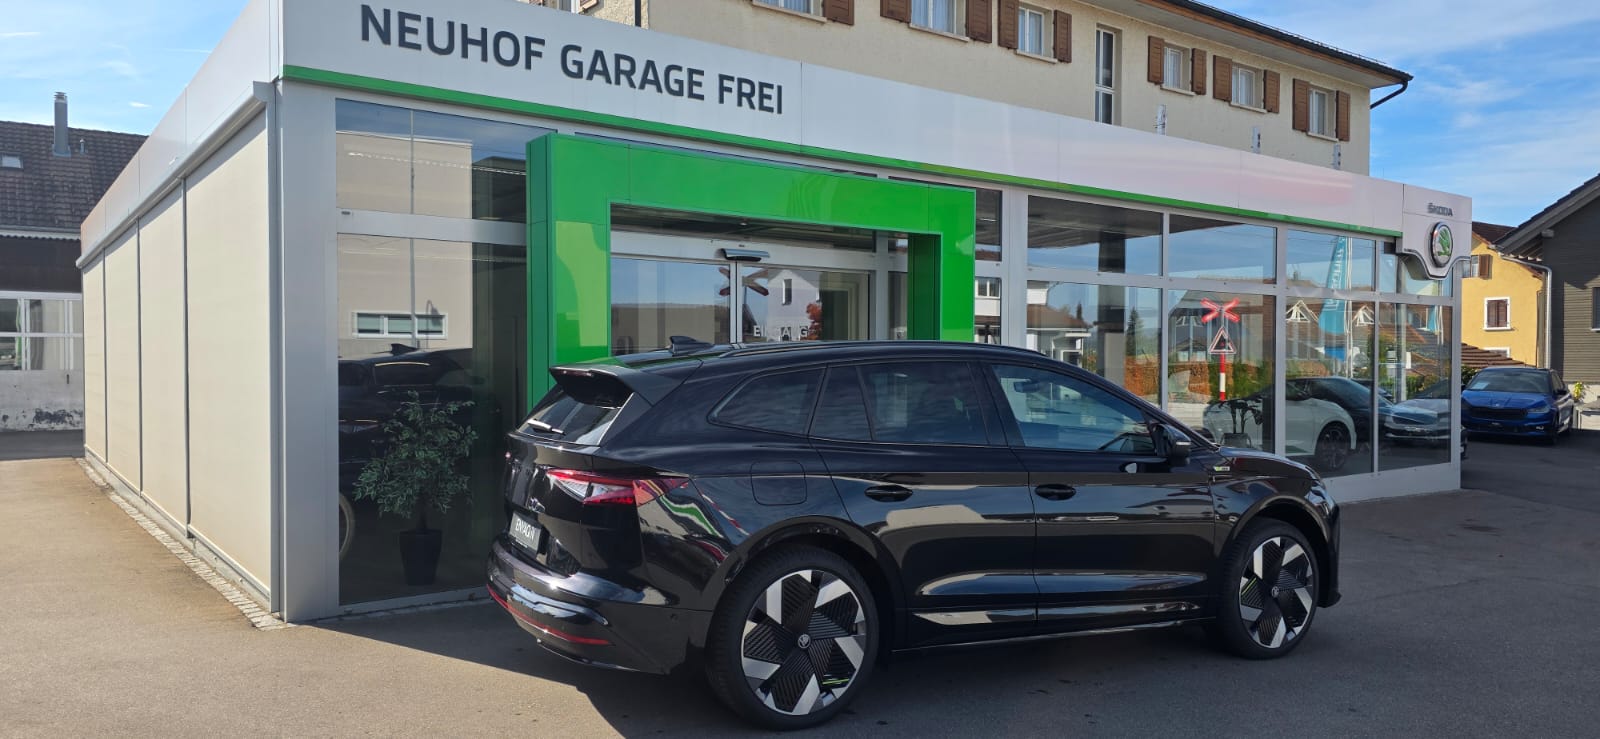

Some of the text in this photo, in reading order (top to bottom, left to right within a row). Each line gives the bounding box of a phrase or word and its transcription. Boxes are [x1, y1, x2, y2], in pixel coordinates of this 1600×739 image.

[360, 4, 783, 115] NEUHOF GARAGE FREI
[1427, 202, 1453, 217] ŠKODA
